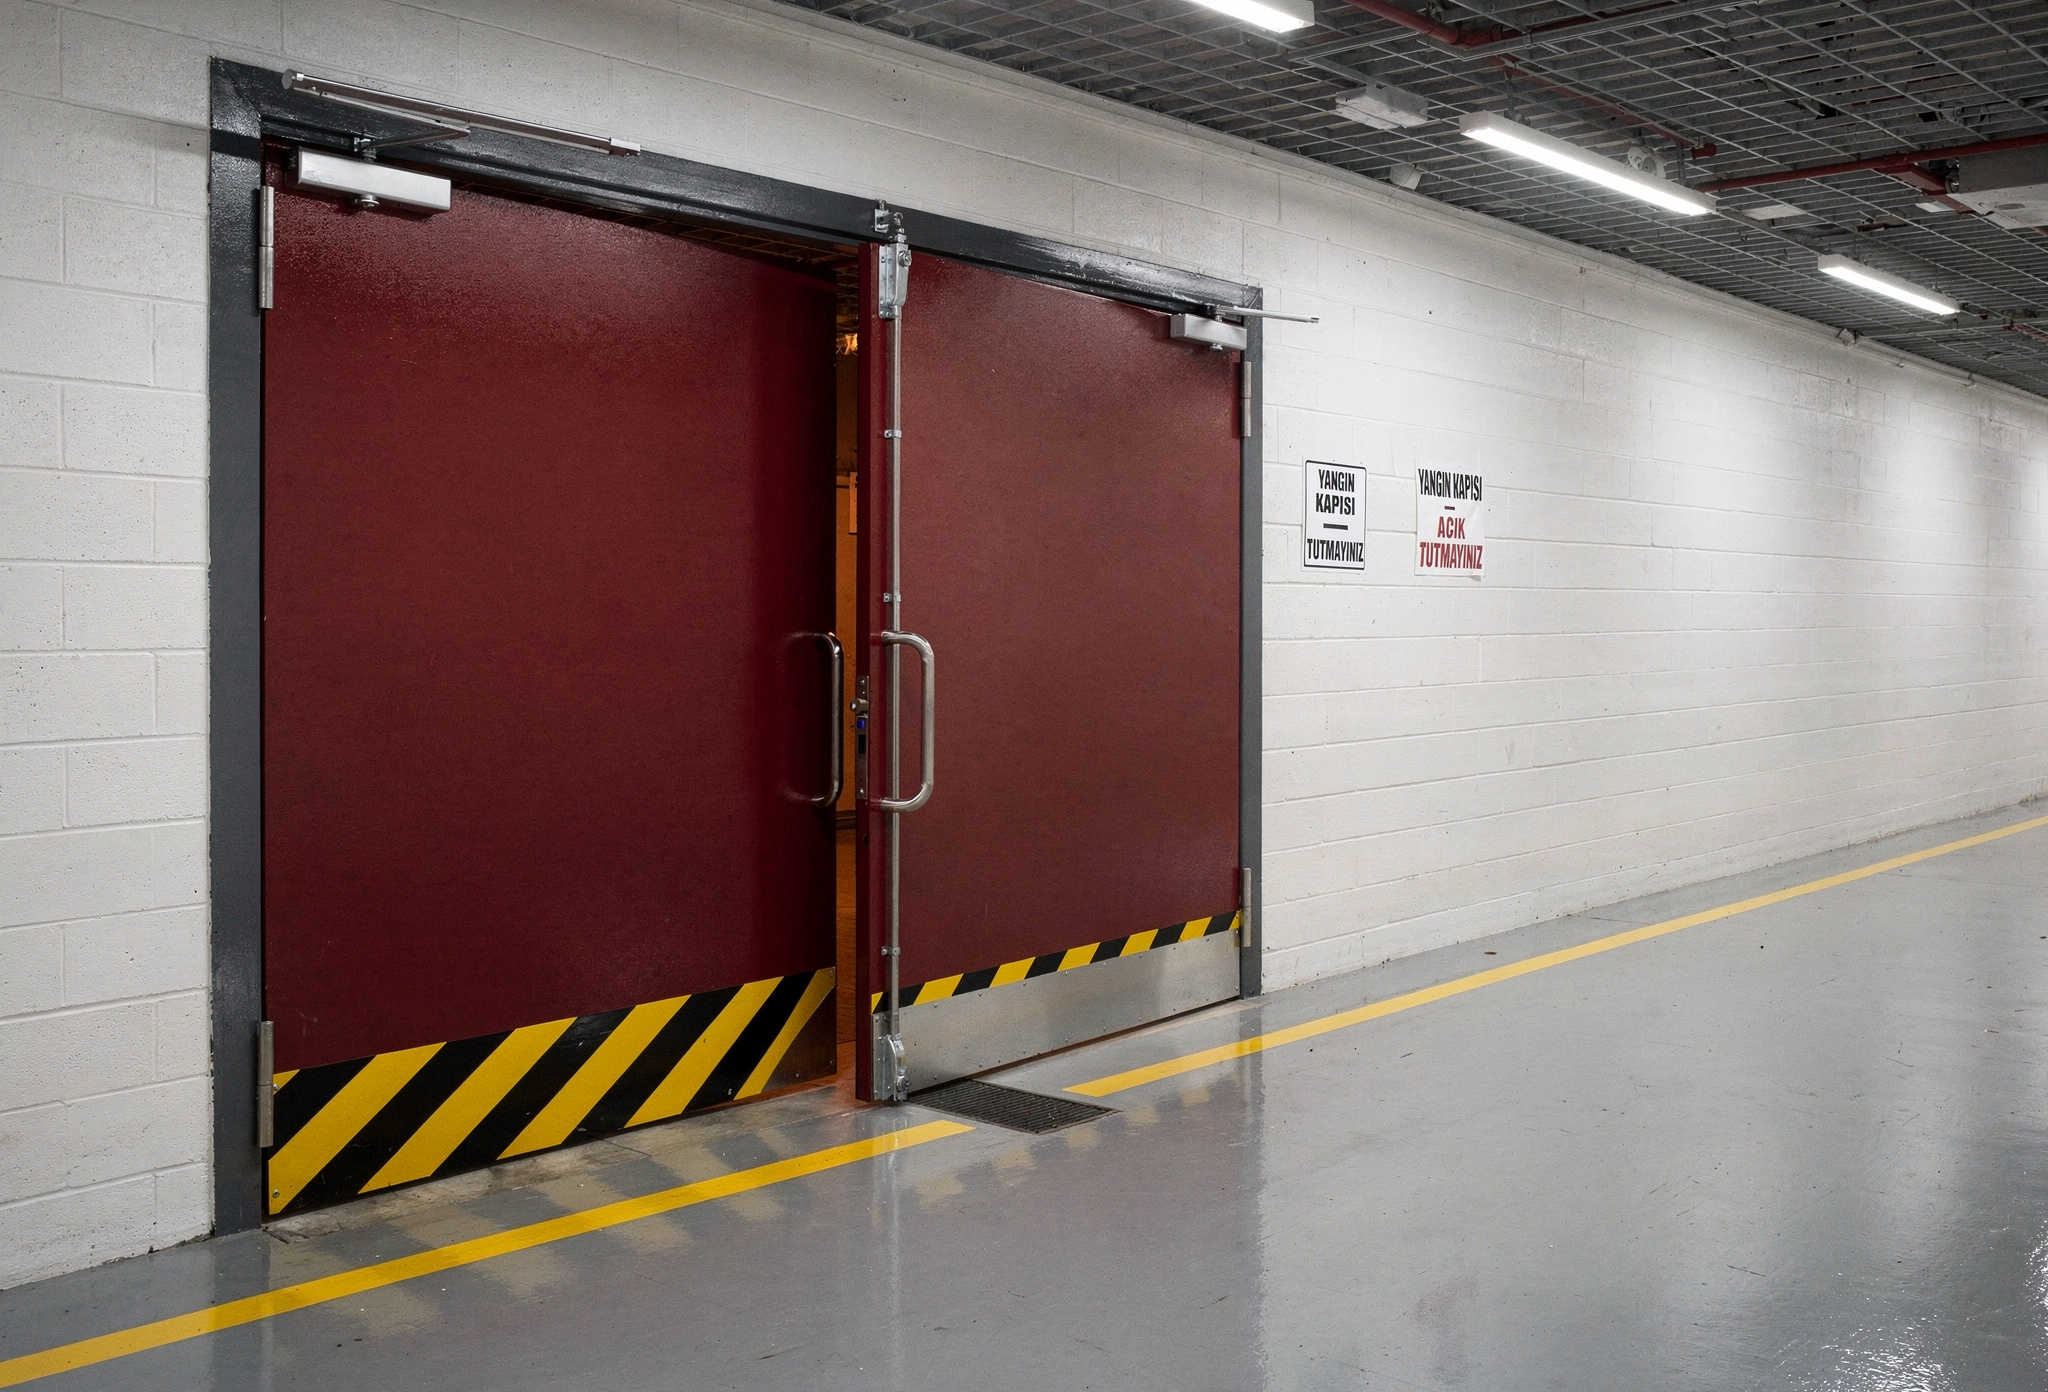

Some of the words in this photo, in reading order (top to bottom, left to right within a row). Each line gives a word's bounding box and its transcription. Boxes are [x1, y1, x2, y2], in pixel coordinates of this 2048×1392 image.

[1318, 469, 1355, 493] YANGIN
[1418, 468, 1451, 498] YANGIN
[1452, 473, 1482, 501] KAPISI
[1316, 493, 1355, 515] KAPISI
[1437, 516, 1466, 539] ACIK
[1307, 538, 1363, 562] TUTMAYINIZ
[1419, 542, 1483, 569] TUTMAYINIZ
